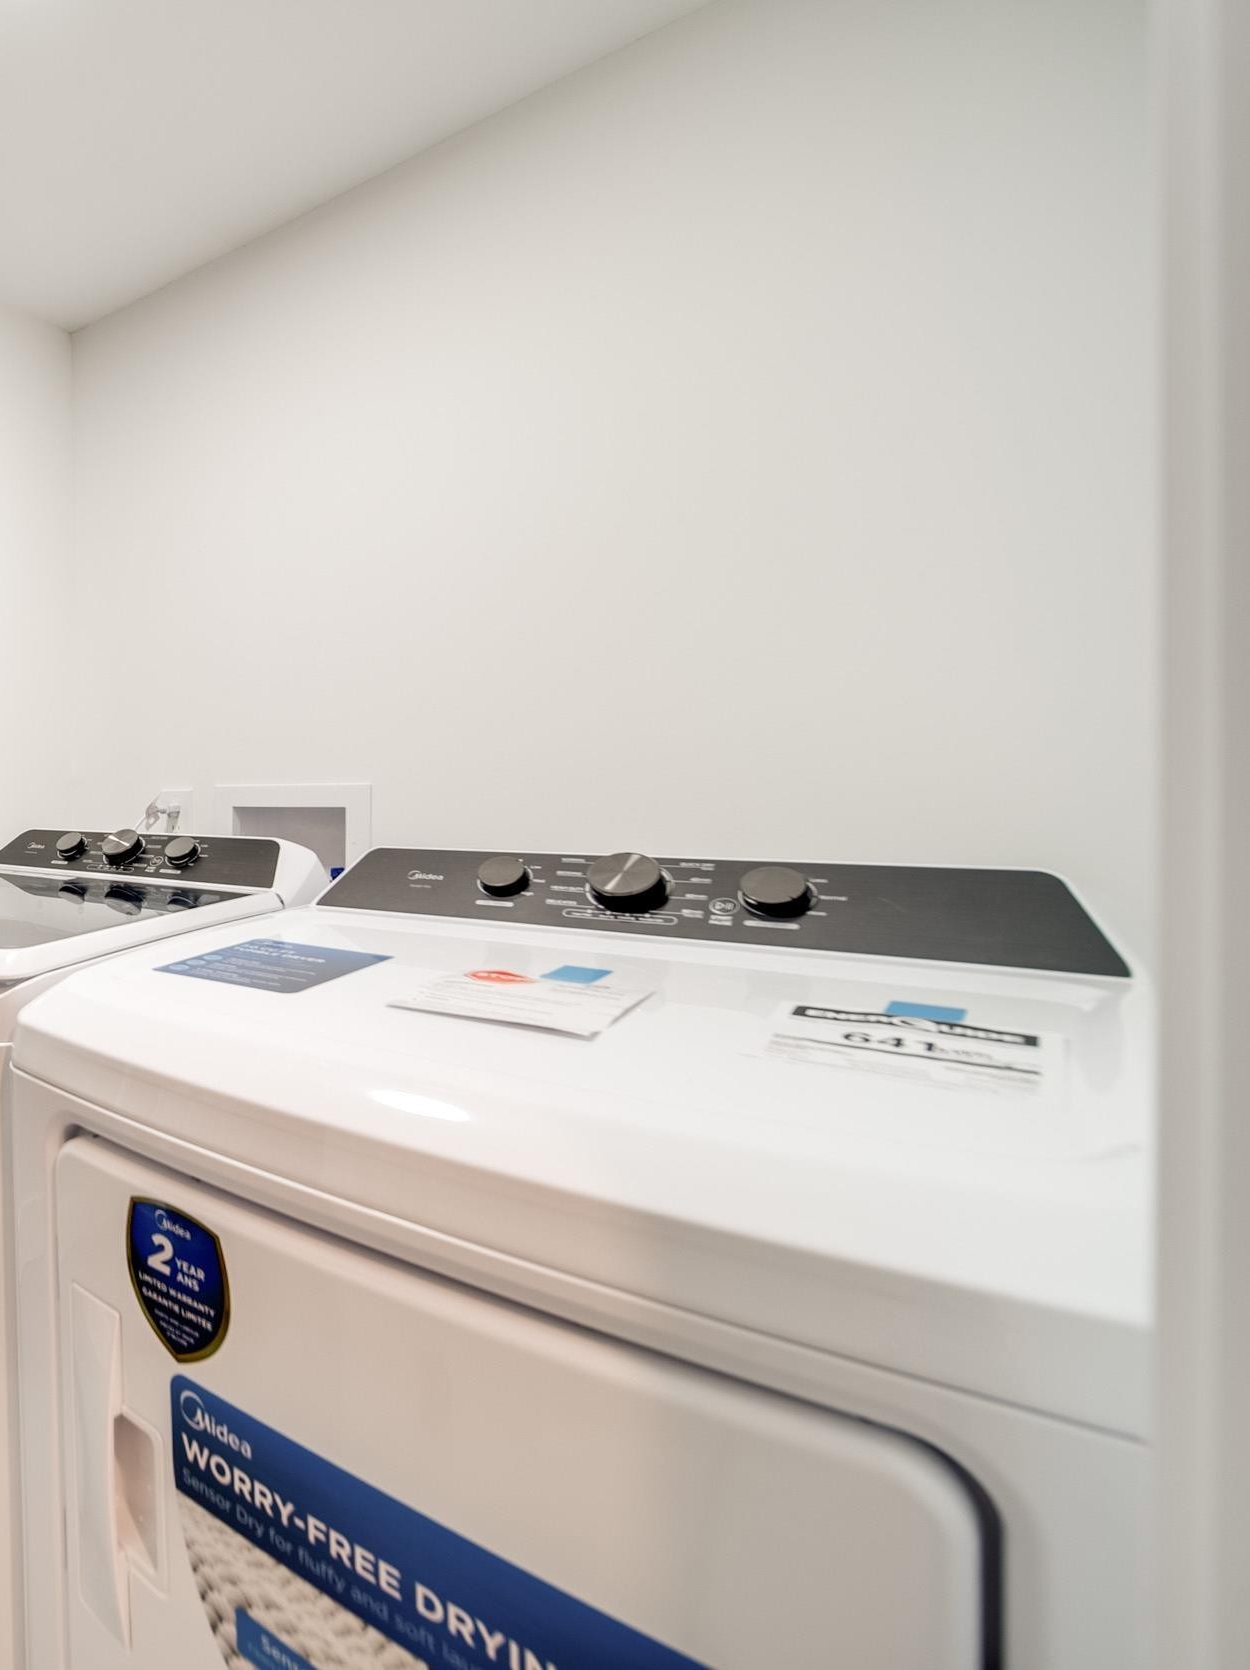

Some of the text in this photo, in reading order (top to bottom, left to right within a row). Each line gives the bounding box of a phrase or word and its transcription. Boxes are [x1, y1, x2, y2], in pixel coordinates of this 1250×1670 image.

[407, 870, 444, 881] Midea
[154, 1208, 191, 1241] Midea
[147, 1233, 205, 1283] 2 YEAR
[176, 1271, 200, 1293] ANS
[138, 1269, 215, 1317] LIMITED WARRANTY
[180, 1389, 252, 1460] Midea
[181, 1431, 558, 1670] WORRY-FREE DRYI
[182, 1467, 231, 1513] Sensor
[236, 1505, 264, 1538] Dry
[269, 1526, 294, 1555] for
[299, 1545, 347, 1593] fluffy
[350, 1583, 389, 1621] and
[394, 1613, 436, 1652] soft
